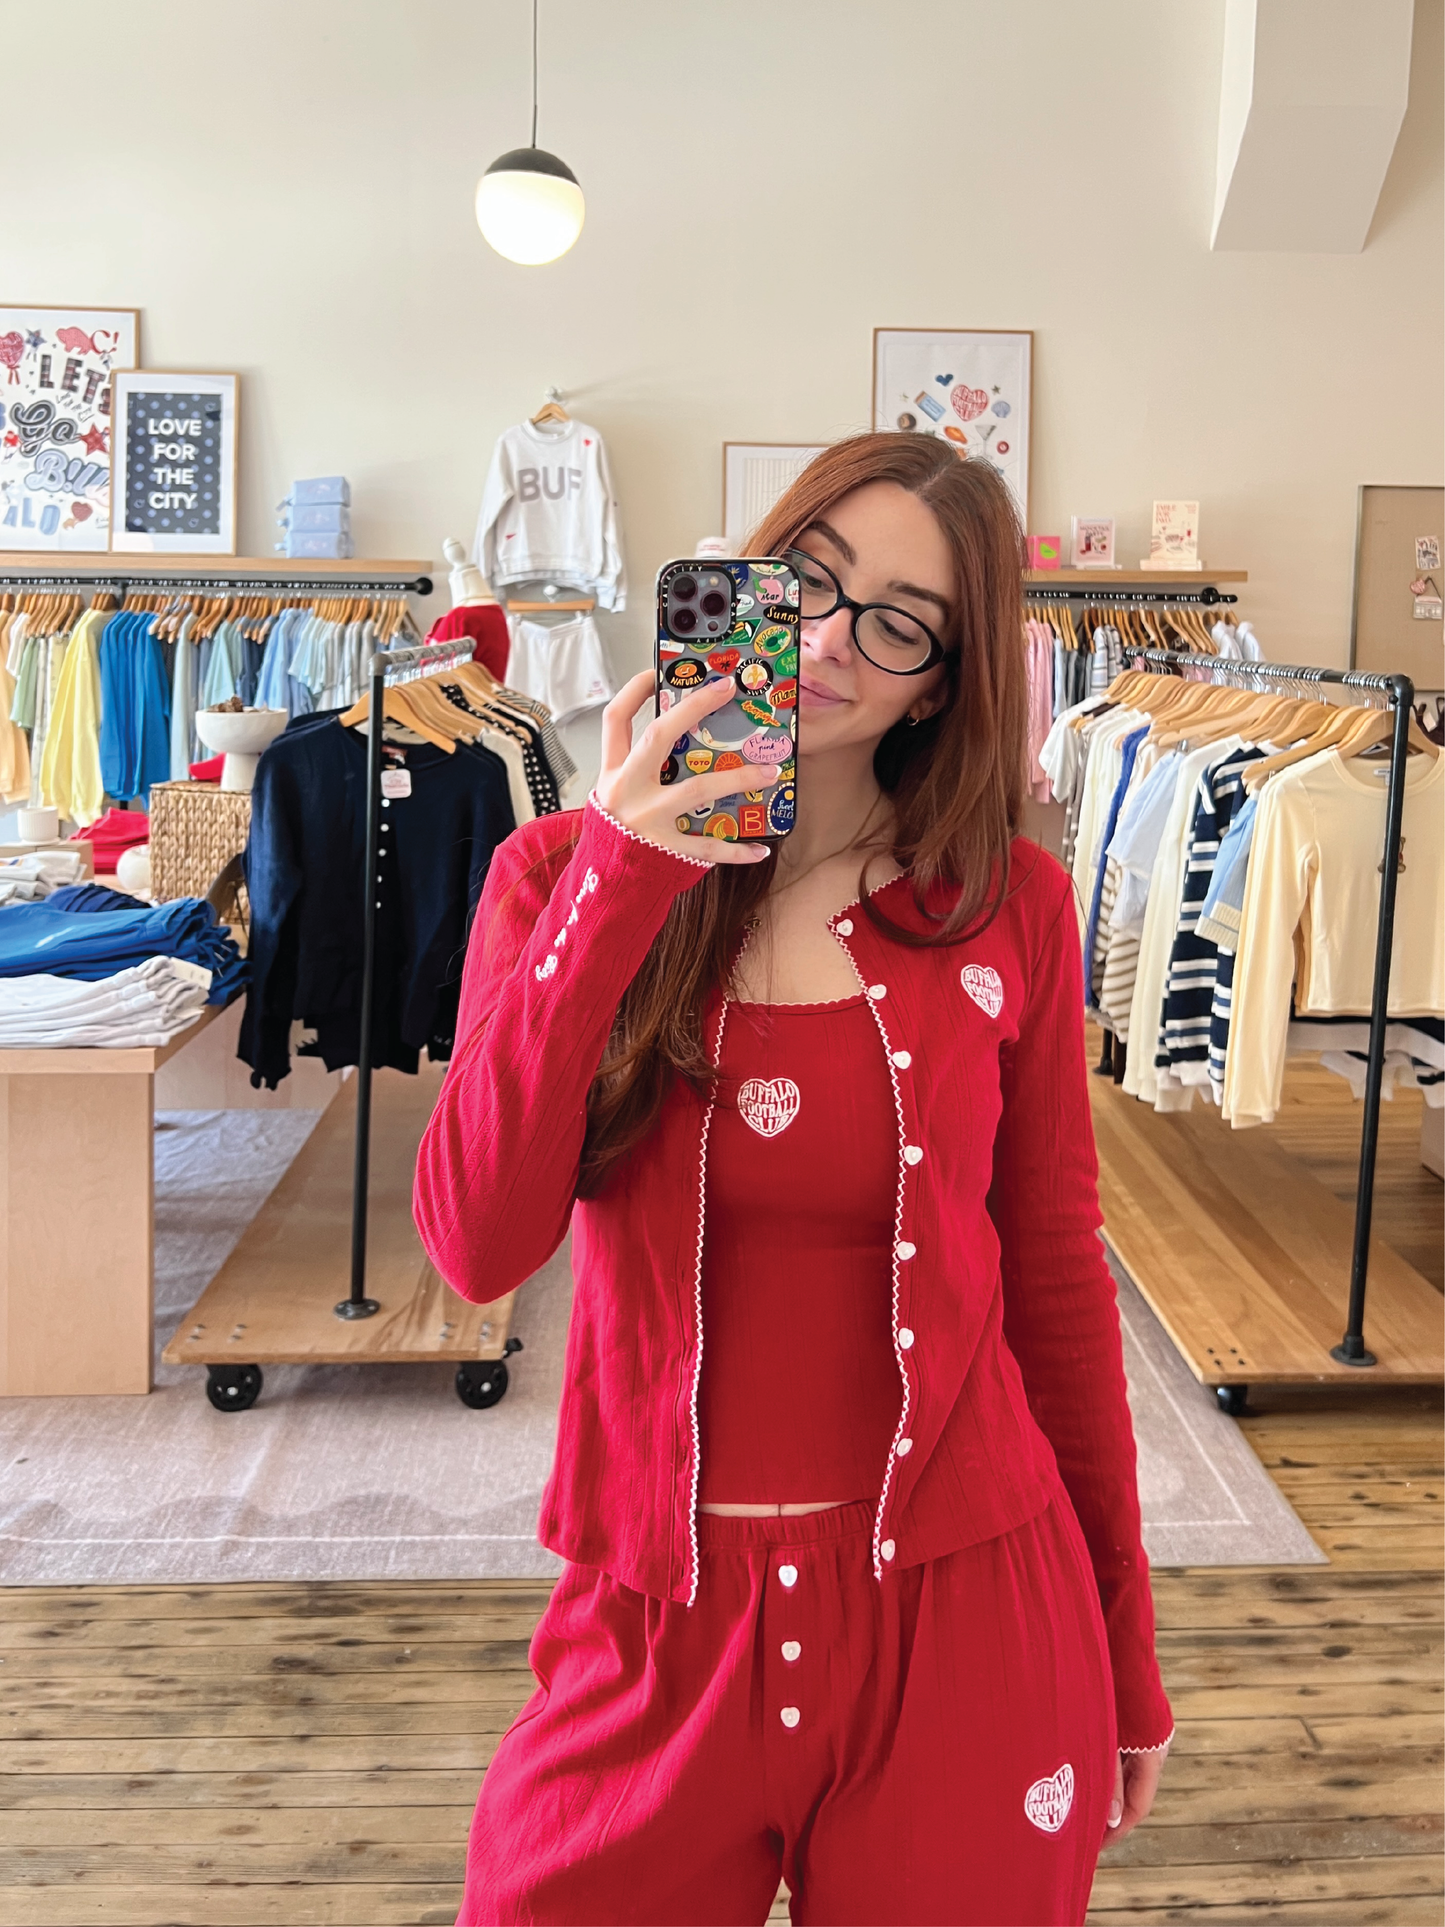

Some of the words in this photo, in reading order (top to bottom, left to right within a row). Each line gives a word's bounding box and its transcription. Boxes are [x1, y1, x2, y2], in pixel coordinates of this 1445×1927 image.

[148, 418, 202, 437] LOVE
[153, 443, 196, 461] FOR
[153, 468, 195, 485] THE
[518, 466, 583, 503] BUF
[149, 493, 198, 510] CITY
[709, 653, 739, 664] FLORIDA
[670, 674, 704, 686] NATURAL
[748, 748, 786, 761] GRAPEFRUIT
[744, 810, 762, 831] B
[740, 1081, 796, 1103] BUFFALO
[740, 1097, 796, 1119] FOOTBALL
[748, 1114, 790, 1133] CLUB
